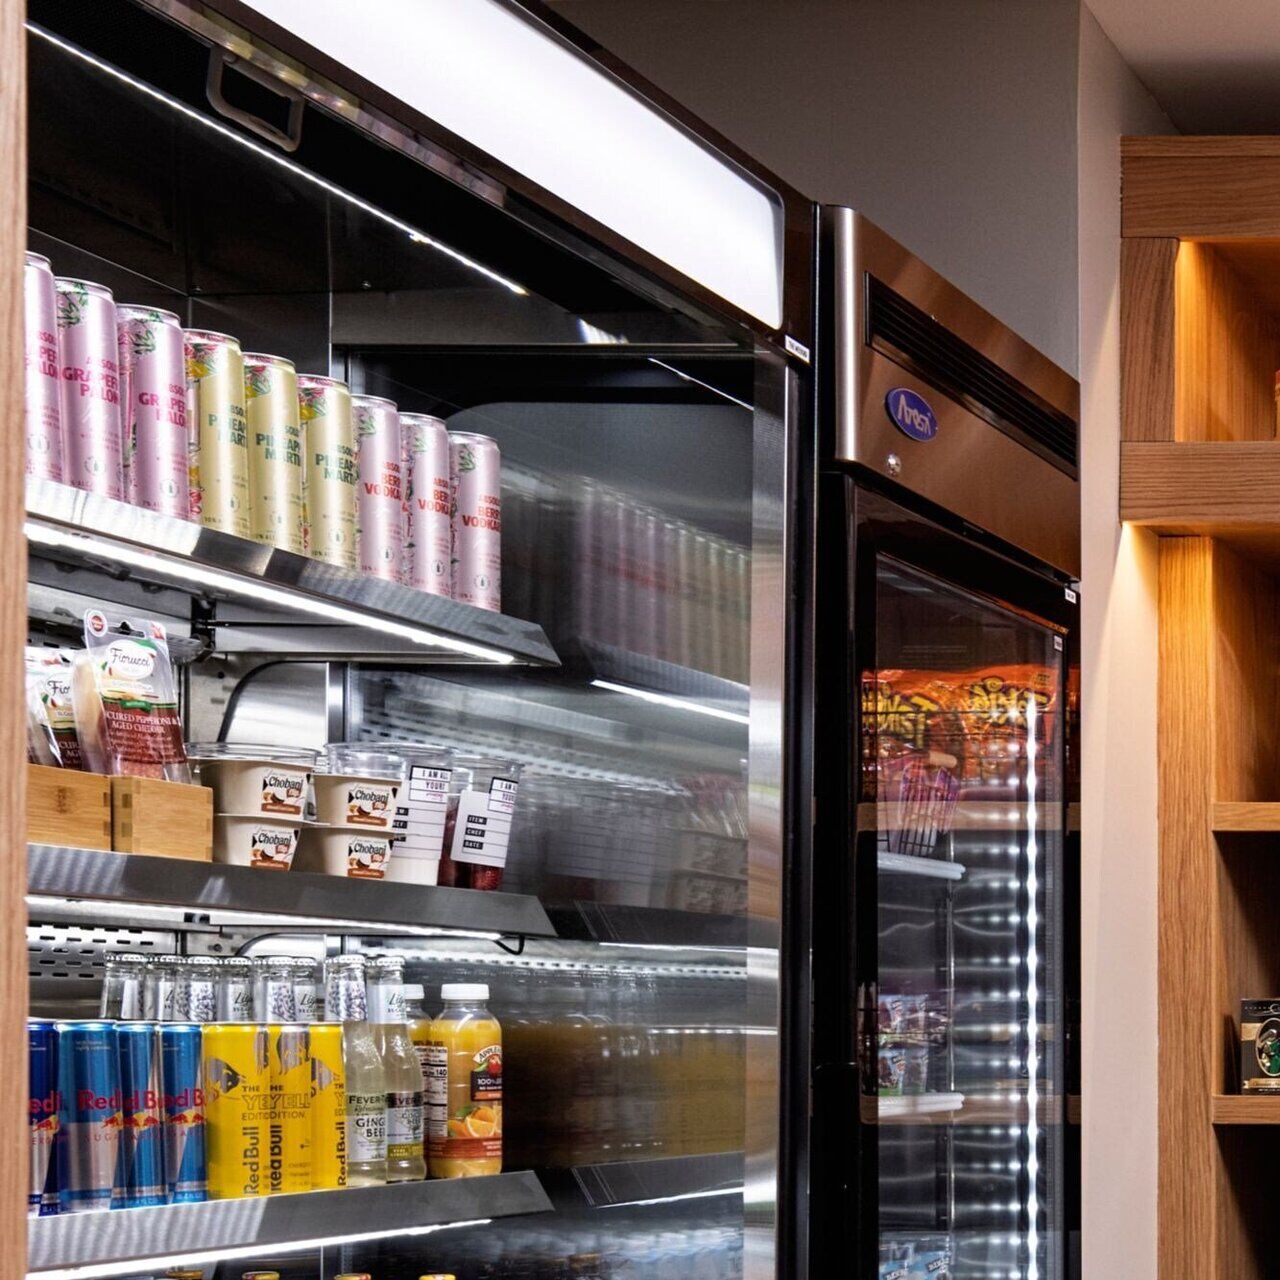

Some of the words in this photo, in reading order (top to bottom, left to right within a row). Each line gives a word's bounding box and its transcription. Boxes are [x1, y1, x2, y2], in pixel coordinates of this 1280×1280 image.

[109, 647, 151, 669] Fiorucci
[112, 721, 133, 730] AGED
[268, 776, 304, 791] Chobani
[354, 789, 389, 804] Chobani
[258, 832, 292, 846] Chobani
[353, 842, 387, 855] Chobani
[242, 1126, 260, 1159] Bull
[335, 1121, 346, 1153] Bull
[243, 1162, 260, 1195] Red
[336, 1155, 347, 1187] Red
